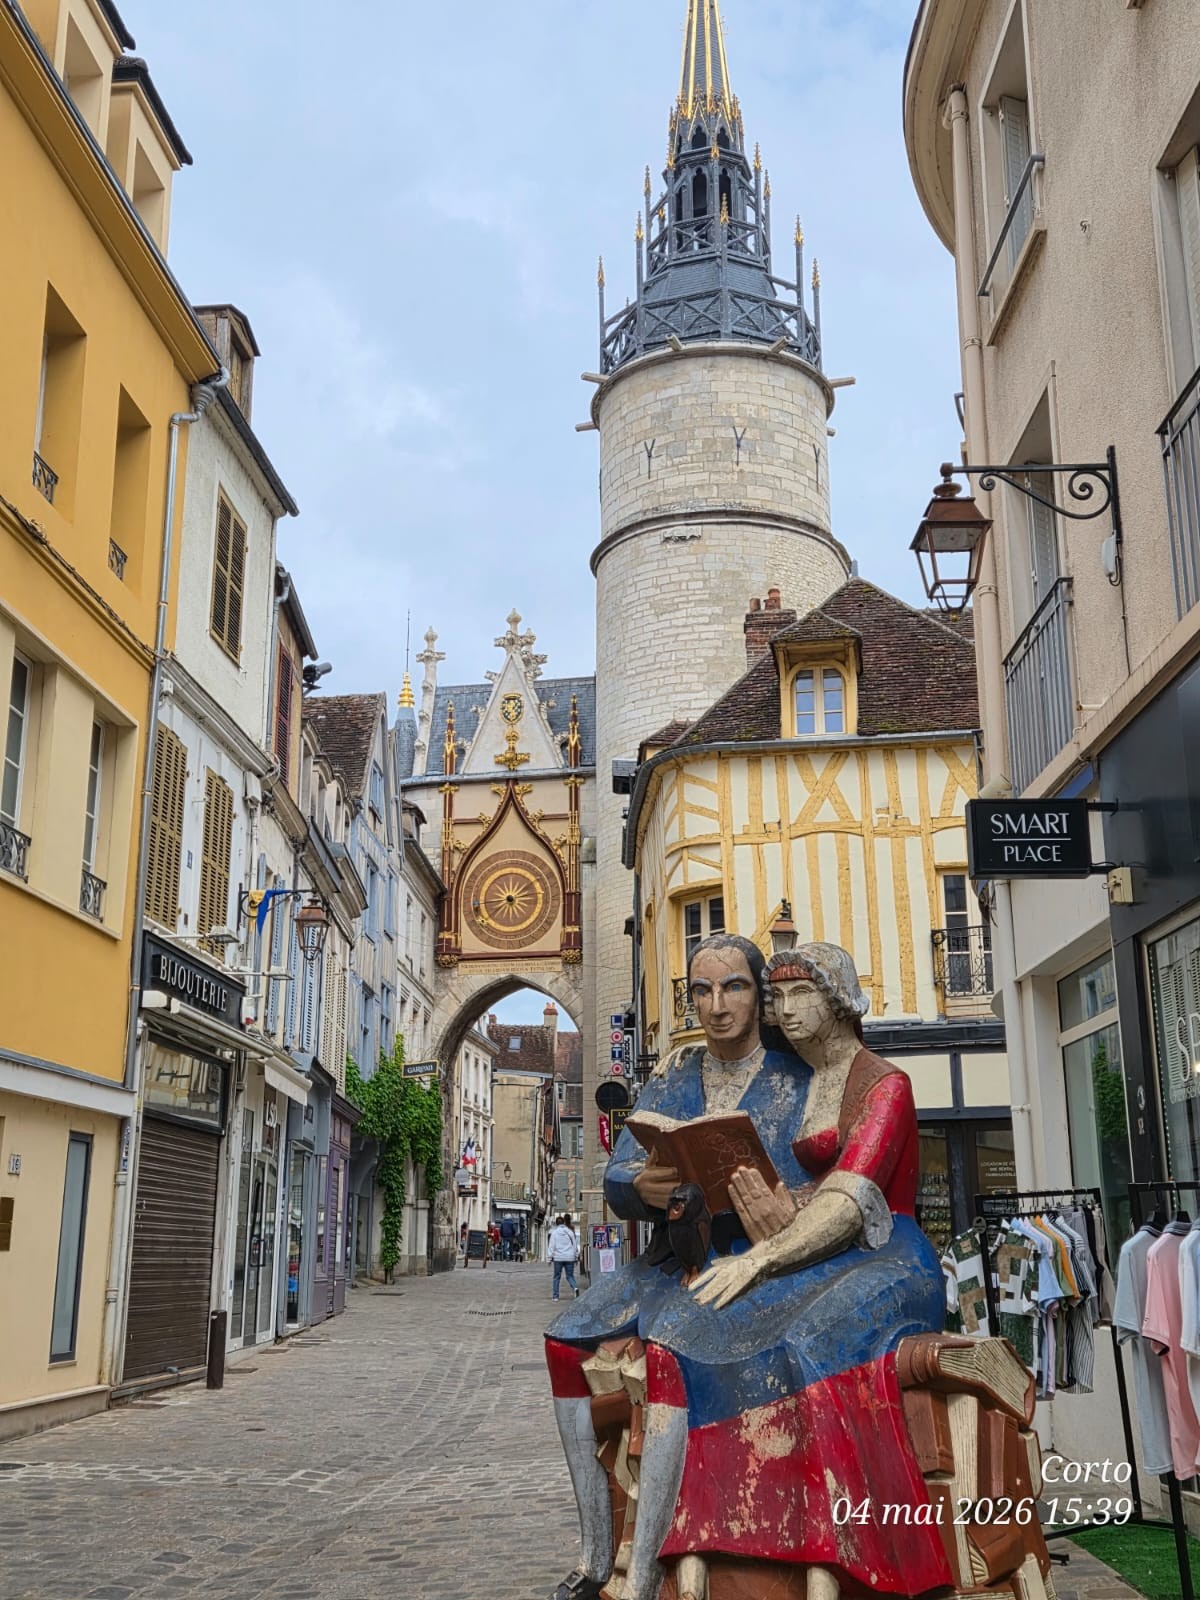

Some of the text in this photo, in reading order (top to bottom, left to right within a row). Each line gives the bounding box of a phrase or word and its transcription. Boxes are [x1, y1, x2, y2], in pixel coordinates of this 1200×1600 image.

[990, 812, 1070, 835] SMART
[1004, 845, 1062, 862] PLACE
[159, 955, 228, 1012] BIJOUTERIE
